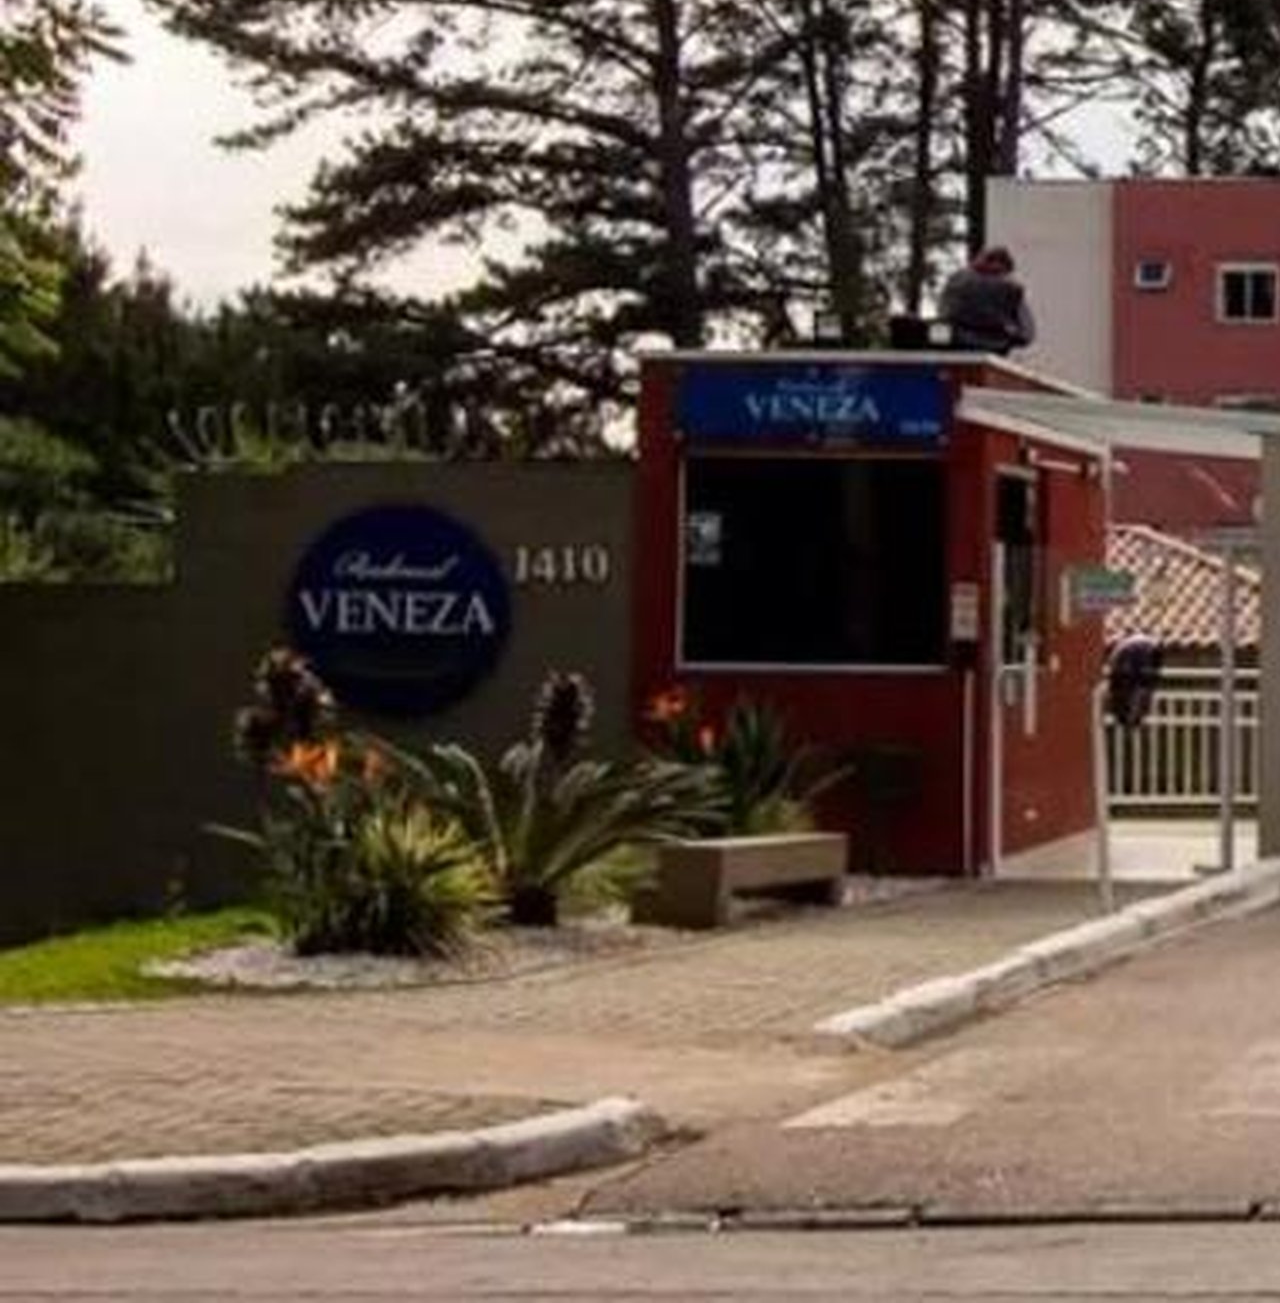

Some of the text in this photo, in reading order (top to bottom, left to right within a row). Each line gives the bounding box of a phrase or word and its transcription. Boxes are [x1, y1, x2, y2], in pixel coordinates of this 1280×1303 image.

[744, 394, 880, 422] VENEZA
[513, 546, 609, 583] 1410
[299, 590, 494, 633] VENEZA
